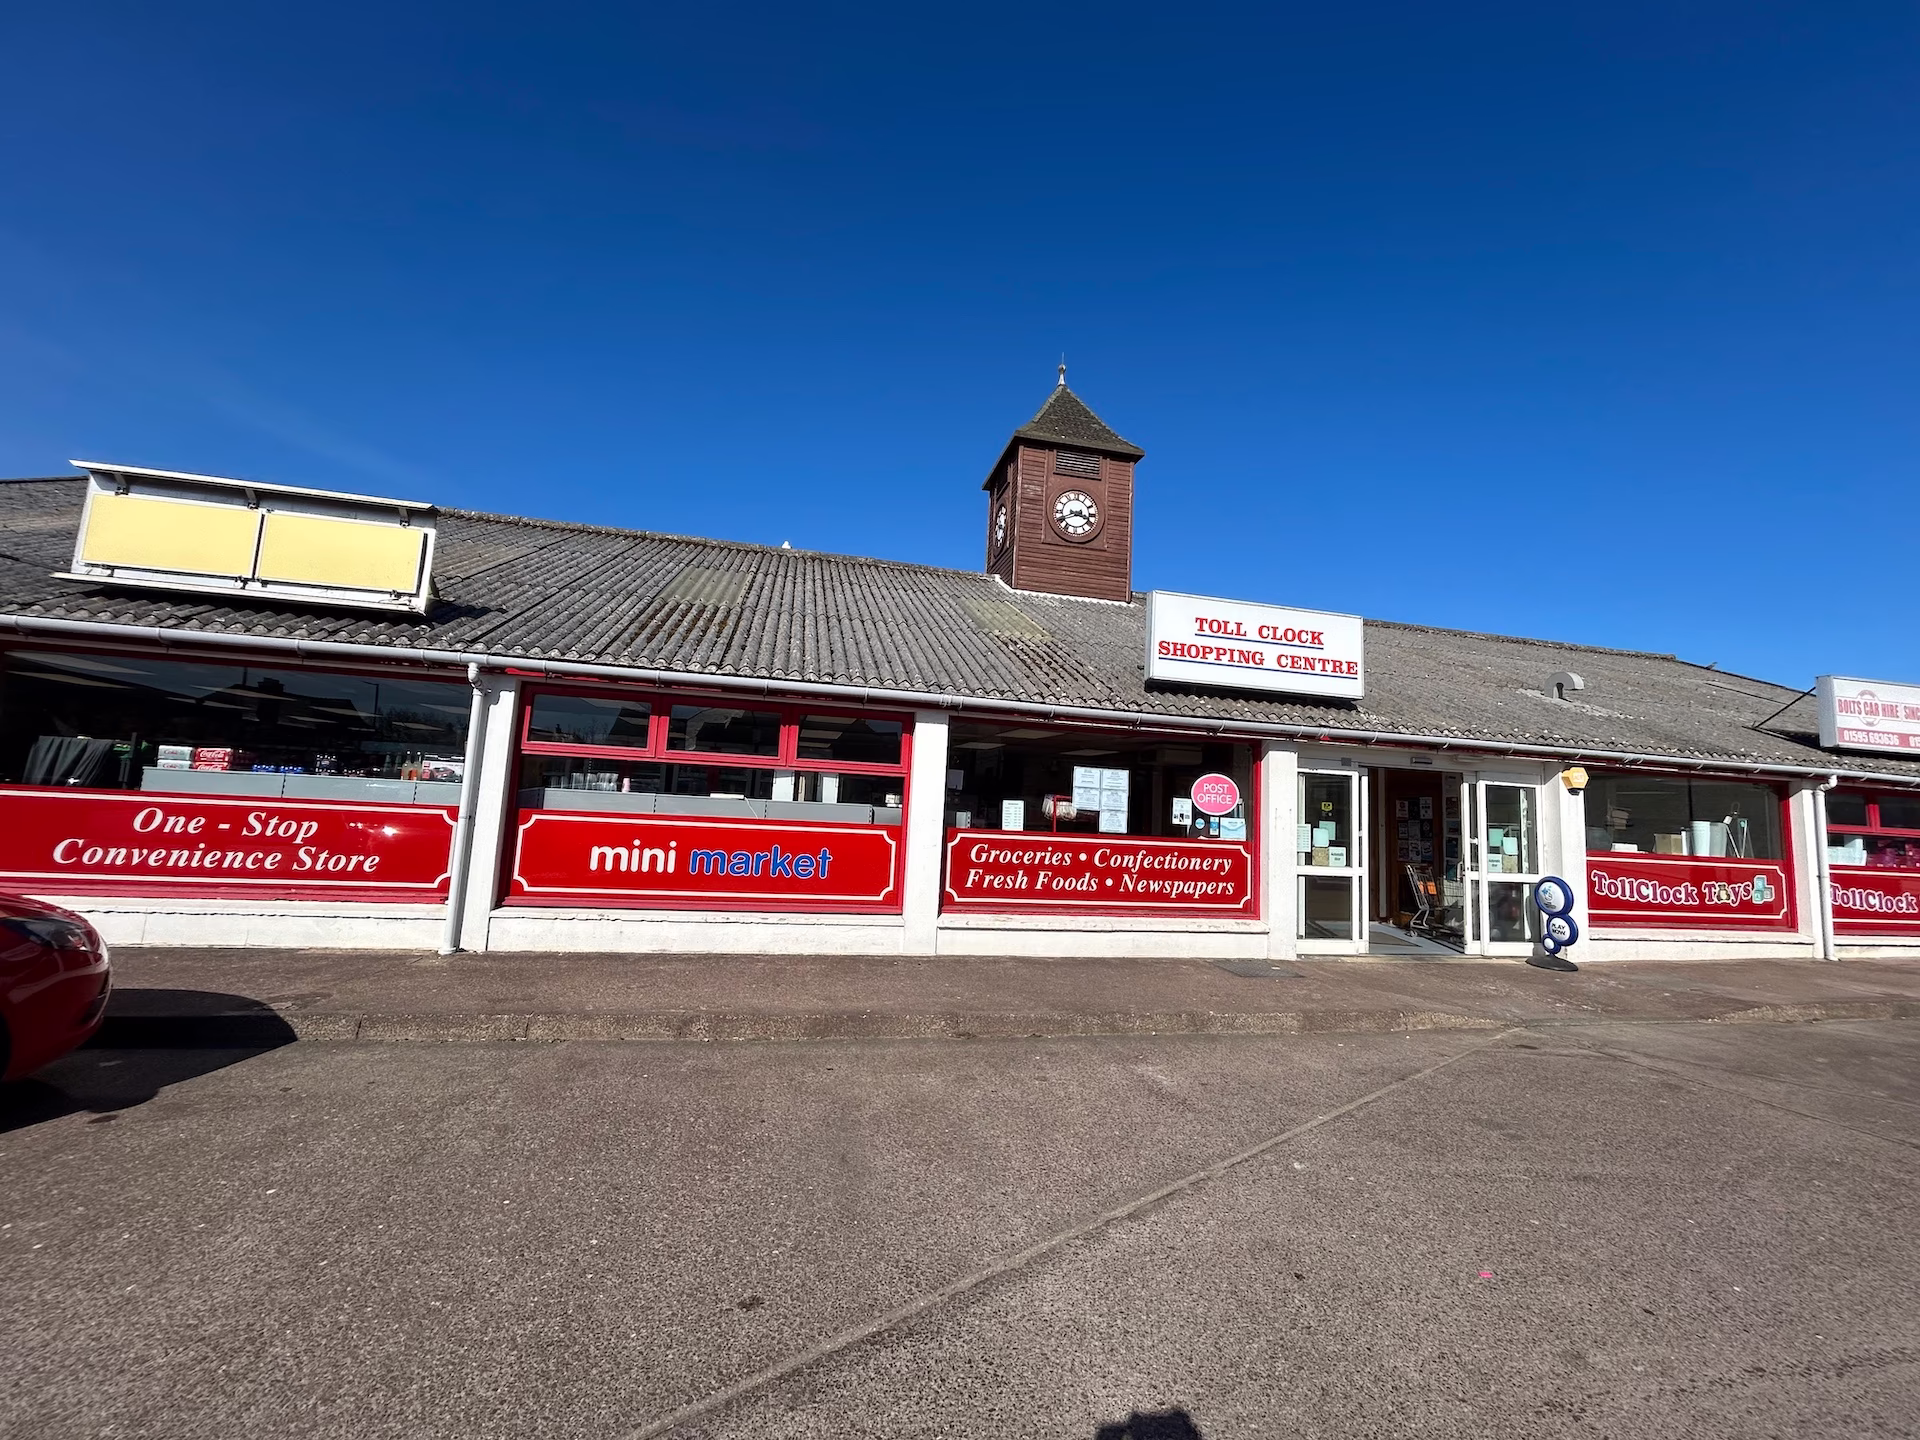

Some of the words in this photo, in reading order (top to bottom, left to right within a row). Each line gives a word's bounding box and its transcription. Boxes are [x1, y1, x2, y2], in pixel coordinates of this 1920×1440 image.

[1195, 617, 1247, 637] TOLL
[1258, 625, 1324, 645] CLOCK
[1158, 640, 1265, 666] SHOPPING
[1276, 654, 1358, 676] CENTRE
[1837, 699, 1862, 715] BOLTS
[1863, 701, 1880, 716] CAR
[1881, 703, 1900, 718] HIRE
[1843, 730, 1868, 742] 01595
[1197, 793, 1232, 805] OFFICE
[1203, 783, 1229, 794] POST
[132, 806, 207, 834] One
[241, 811, 319, 845] Stop
[52, 838, 283, 870] Convenience
[292, 846, 380, 874] Store
[588, 838, 677, 874] mini
[688, 844, 833, 880] market
[969, 843, 1073, 866] Groceries
[1093, 849, 1233, 876] Confectionery
[965, 869, 1028, 890] Fresh
[1034, 871, 1099, 892] Foods
[1119, 874, 1235, 898] Newspapers
[1591, 870, 1699, 905] TollClock
[1830, 882, 1919, 913] TollClock
